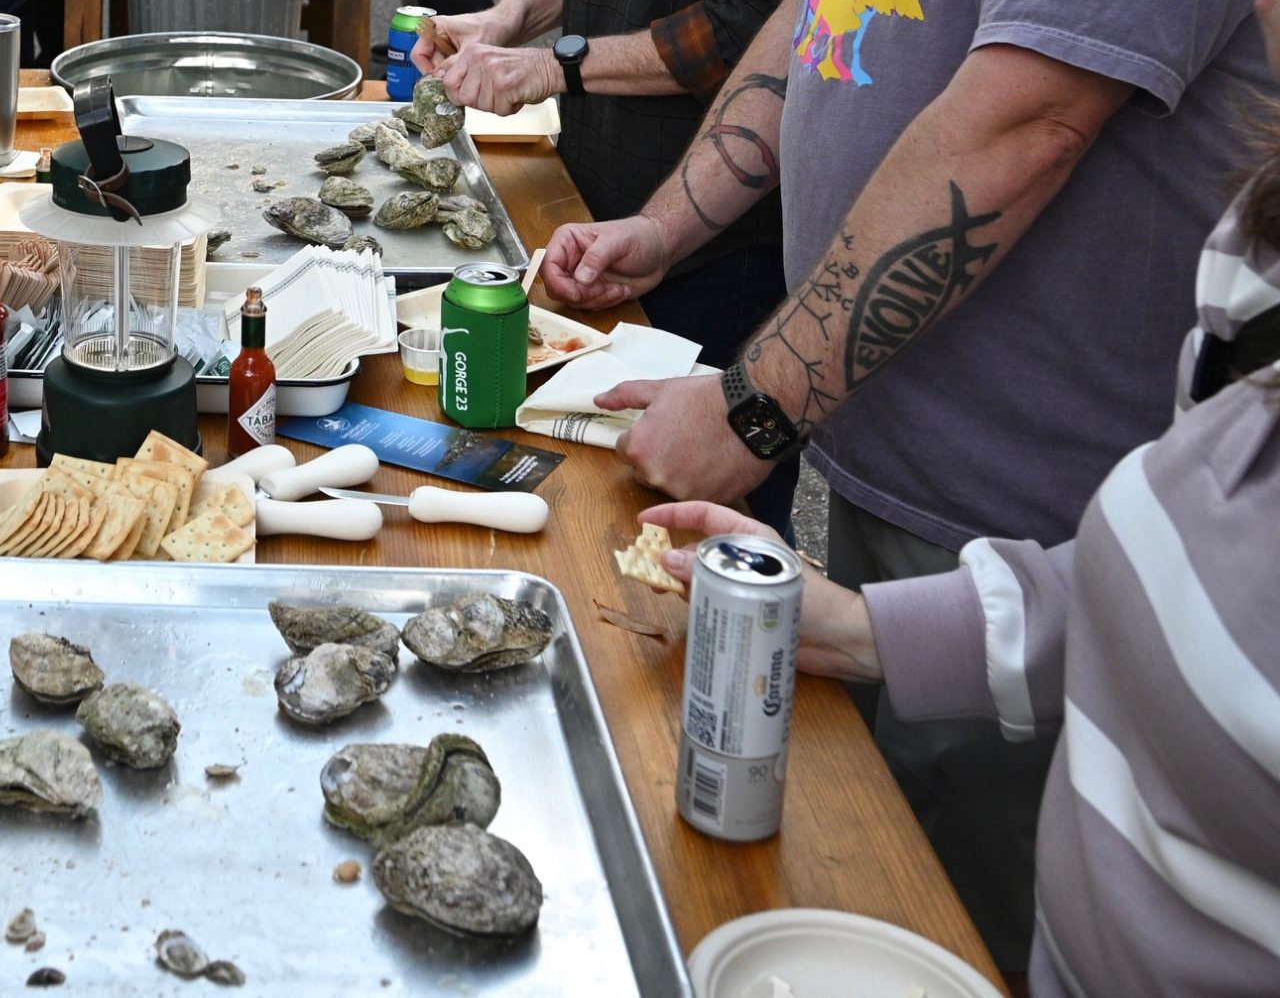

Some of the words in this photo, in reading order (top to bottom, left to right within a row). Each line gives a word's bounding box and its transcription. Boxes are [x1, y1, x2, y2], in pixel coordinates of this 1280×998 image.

[855, 243, 951, 370] EVOLVE
[455, 352, 467, 395] GORGE
[455, 395, 468, 411] 23
[763, 647, 785, 718] Corona
[748, 765, 768, 778] 90
